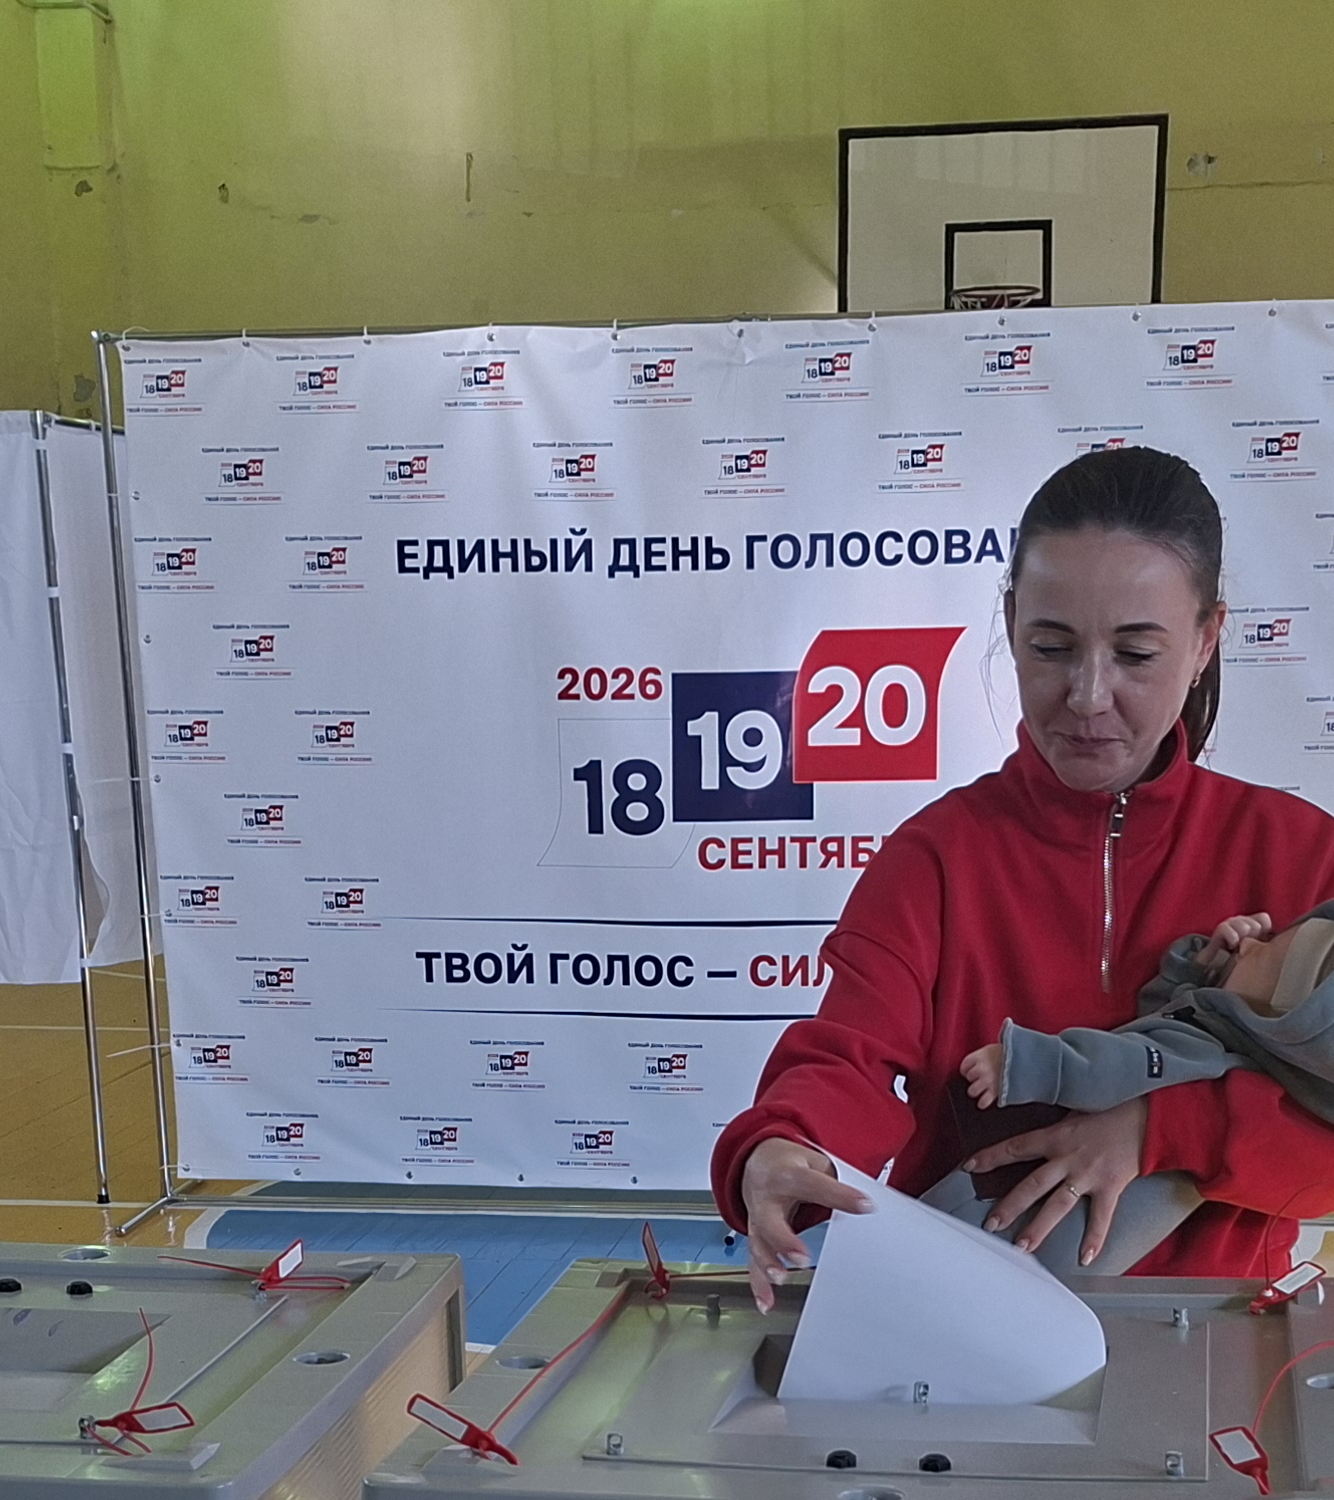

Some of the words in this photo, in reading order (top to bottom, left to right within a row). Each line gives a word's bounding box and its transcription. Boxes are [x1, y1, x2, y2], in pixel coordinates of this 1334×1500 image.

[986, 363, 997, 372] 18
[1001, 356, 1012, 366] 19
[1015, 350, 1028, 360] 20
[1168, 357, 1179, 366] 18
[1183, 351, 1194, 360] 19
[1198, 344, 1212, 354] 20
[463, 378, 473, 386] 18
[476, 371, 486, 381] 19
[489, 366, 502, 375] 20
[633, 375, 642, 384] 18
[645, 369, 656, 378] 19
[659, 364, 672, 373] 20
[807, 369, 817, 379] 18
[821, 363, 832, 373] 19
[835, 357, 848, 367] 20
[145, 385, 154, 394] 18
[157, 379, 168, 388] 19
[171, 374, 183, 383] 20
[298, 382, 308, 391] 18
[310, 376, 320, 385] 19
[324, 370, 336, 379] 20
[1253, 449, 1264, 458] 18
[1268, 443, 1279, 452] 19
[1283, 437, 1297, 447] 20
[555, 469, 564, 478] 18
[568, 463, 578, 473] 19
[581, 458, 593, 468] 20
[724, 466, 733, 474] 18
[736, 460, 748, 469] 19
[751, 454, 764, 463] 20
[899, 461, 909, 469] 18
[913, 454, 925, 464] 19
[927, 449, 940, 458] 20
[223, 474, 233, 483] 18
[236, 469, 247, 478] 19
[249, 463, 261, 472] 20
[387, 472, 397, 480] 18
[400, 466, 411, 475] 19
[413, 460, 425, 470] 20
[156, 563, 165, 572] 18
[169, 558, 179, 566] 19
[182, 552, 194, 561] 20
[307, 562, 316, 570] 18
[319, 556, 329, 565] 19
[332, 551, 344, 560] 20
[397, 528, 592, 580] ЕДИНЫЙ
[608, 535, 730, 578] ДЕНЬ
[1245, 634, 1255, 643] 18
[1259, 628, 1271, 638] 19
[1274, 623, 1287, 633] 20
[234, 650, 244, 659] 18
[246, 644, 257, 653] 19
[260, 639, 272, 648] 20
[558, 667, 663, 700] 2026
[168, 734, 178, 743] 18
[180, 729, 191, 738] 19
[194, 724, 206, 733] 20
[315, 735, 325, 743] 18
[328, 729, 338, 739] 19
[341, 725, 352, 734] 20
[573, 759, 664, 835] 18
[687, 709, 783, 790] 19
[807, 665, 927, 746] 20
[244, 818, 254, 827] 18
[257, 813, 267, 822] 19
[270, 808, 281, 817] 20
[181, 899, 190, 907] 18
[193, 894, 203, 903] 19
[206, 889, 217, 898] 20
[324, 901, 334, 910] 18
[350, 891, 361, 900] 20
[416, 943, 534, 985] ТВОЙ
[549, 952, 694, 988] ГОЛОС
[255, 981, 265, 989] 18
[280, 971, 292, 980] 20
[193, 1057, 202, 1065] 18
[217, 1047, 228, 1056] 20
[334, 1060, 343, 1068] 18
[358, 1051, 369, 1060] 20
[489, 1064, 499, 1072] 18
[514, 1054, 526, 1063] 20
[647, 1067, 657, 1075] 18
[672, 1057, 685, 1066] 20
[266, 1135, 275, 1143] 18
[289, 1126, 301, 1134] 20
[419, 1139, 429, 1147] 18
[443, 1130, 455, 1138] 20
[574, 1142, 584, 1151] 18
[600, 1133, 612, 1142] 20
